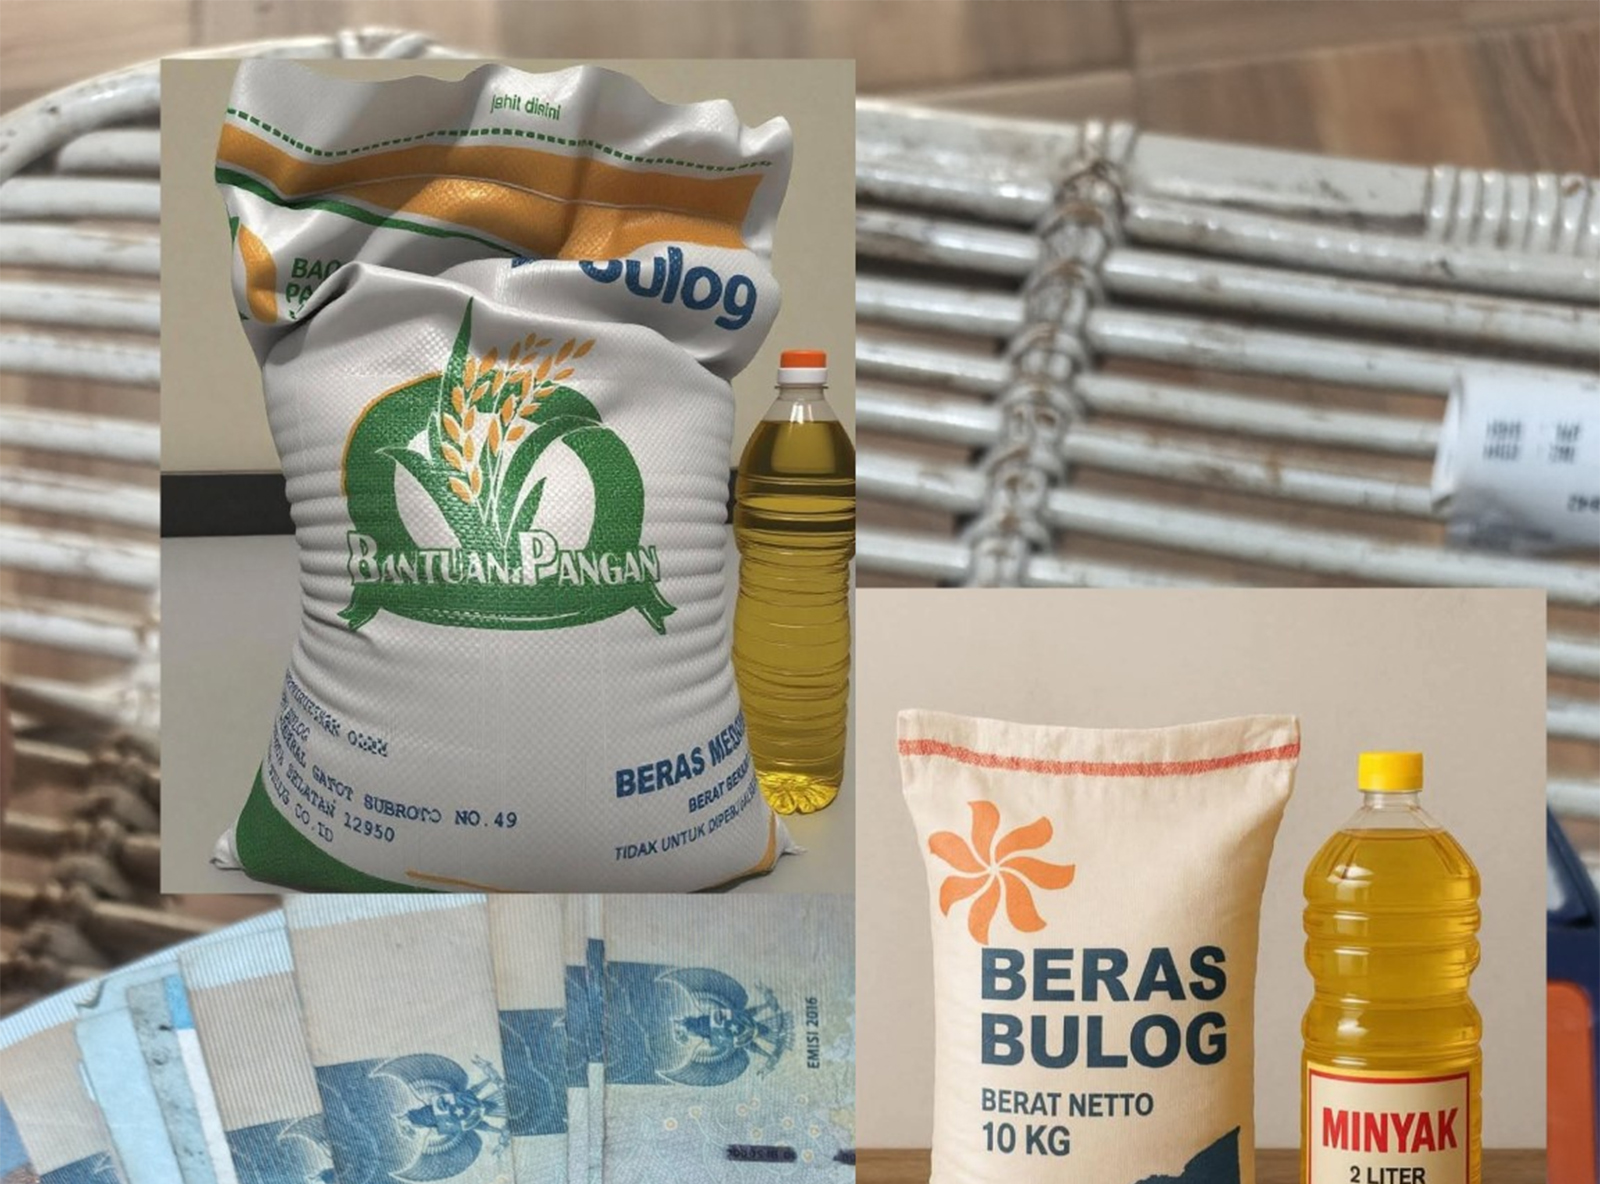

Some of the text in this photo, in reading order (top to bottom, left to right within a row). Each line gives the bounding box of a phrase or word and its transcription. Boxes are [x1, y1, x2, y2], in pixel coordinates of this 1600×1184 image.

[347, 529, 661, 586] BANTUAN PANGAN
[616, 746, 705, 798] BERAS
[689, 780, 725, 813] BERAT
[343, 812, 395, 842] 12950
[661, 823, 706, 852] UNTUK
[981, 946, 1227, 1002] BERAS
[806, 996, 820, 1070] EMISI 2016
[981, 1011, 1227, 1069] BULOG
[981, 1088, 1154, 1117] BERAT NETTO
[982, 1121, 1070, 1156] 10 KG
[1323, 1106, 1458, 1153] MINYAK
[1350, 1165, 1360, 1183] 2
